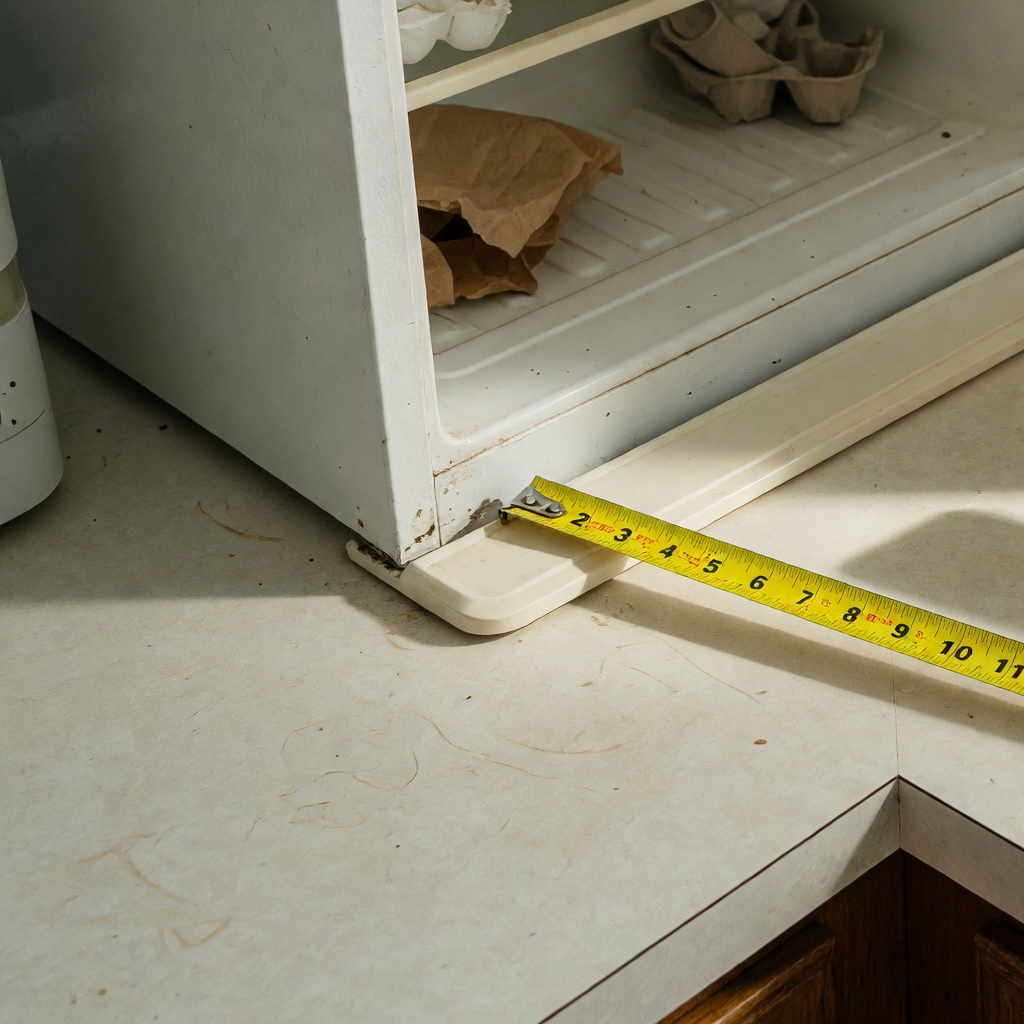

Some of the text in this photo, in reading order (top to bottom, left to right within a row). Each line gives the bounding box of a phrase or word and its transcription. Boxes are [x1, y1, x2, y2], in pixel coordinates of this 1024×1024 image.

[570, 512, 591, 528] 2
[613, 527, 633, 542] 3
[658, 544, 678, 559] 4
[702, 558, 723, 574] 5
[749, 575, 768, 590] 6
[795, 589, 815, 605] 7
[842, 606, 862, 623] 8
[890, 623, 910, 639] 9
[940, 640, 973, 661] 10
[994, 659, 1024, 679] 11
